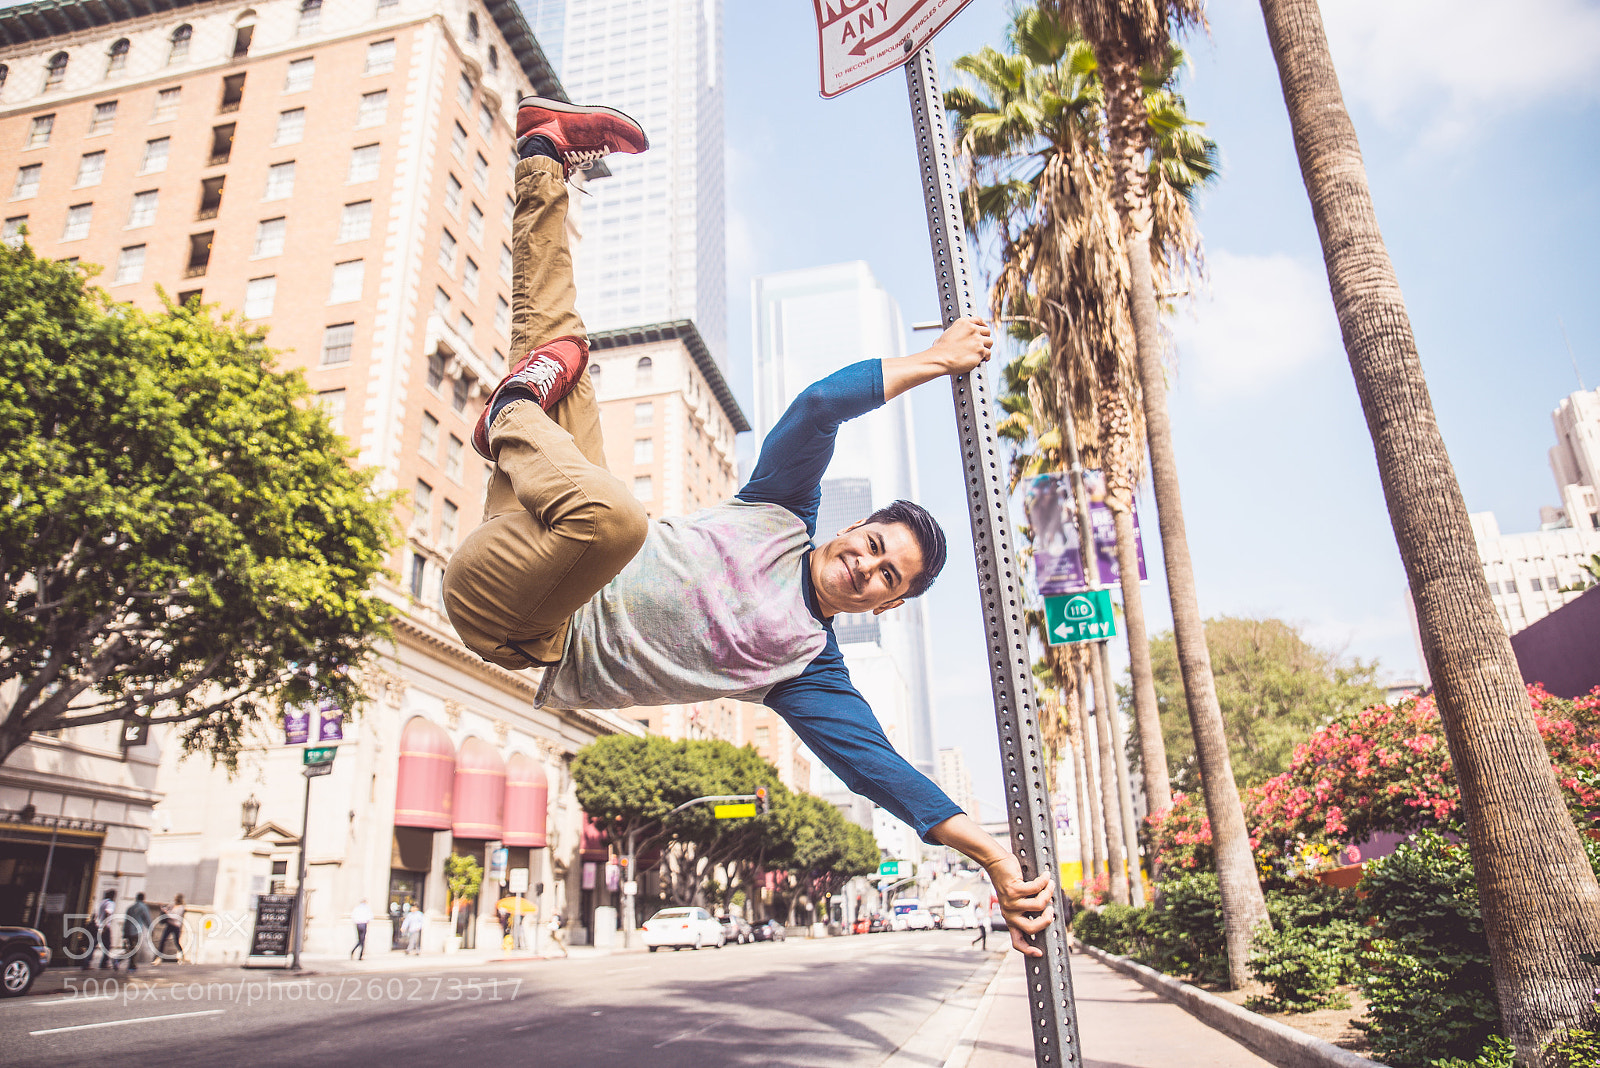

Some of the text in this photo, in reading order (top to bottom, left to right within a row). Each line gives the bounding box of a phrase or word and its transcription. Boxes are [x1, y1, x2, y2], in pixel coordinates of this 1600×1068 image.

[841, 0, 889, 45] ANY
[844, 56, 875, 75] RECOVER
[876, 33, 911, 58] IMPOUNDED
[911, 6, 937, 34] VEHICLES
[1070, 604, 1088, 616] 110
[1078, 621, 1110, 636] Fwy
